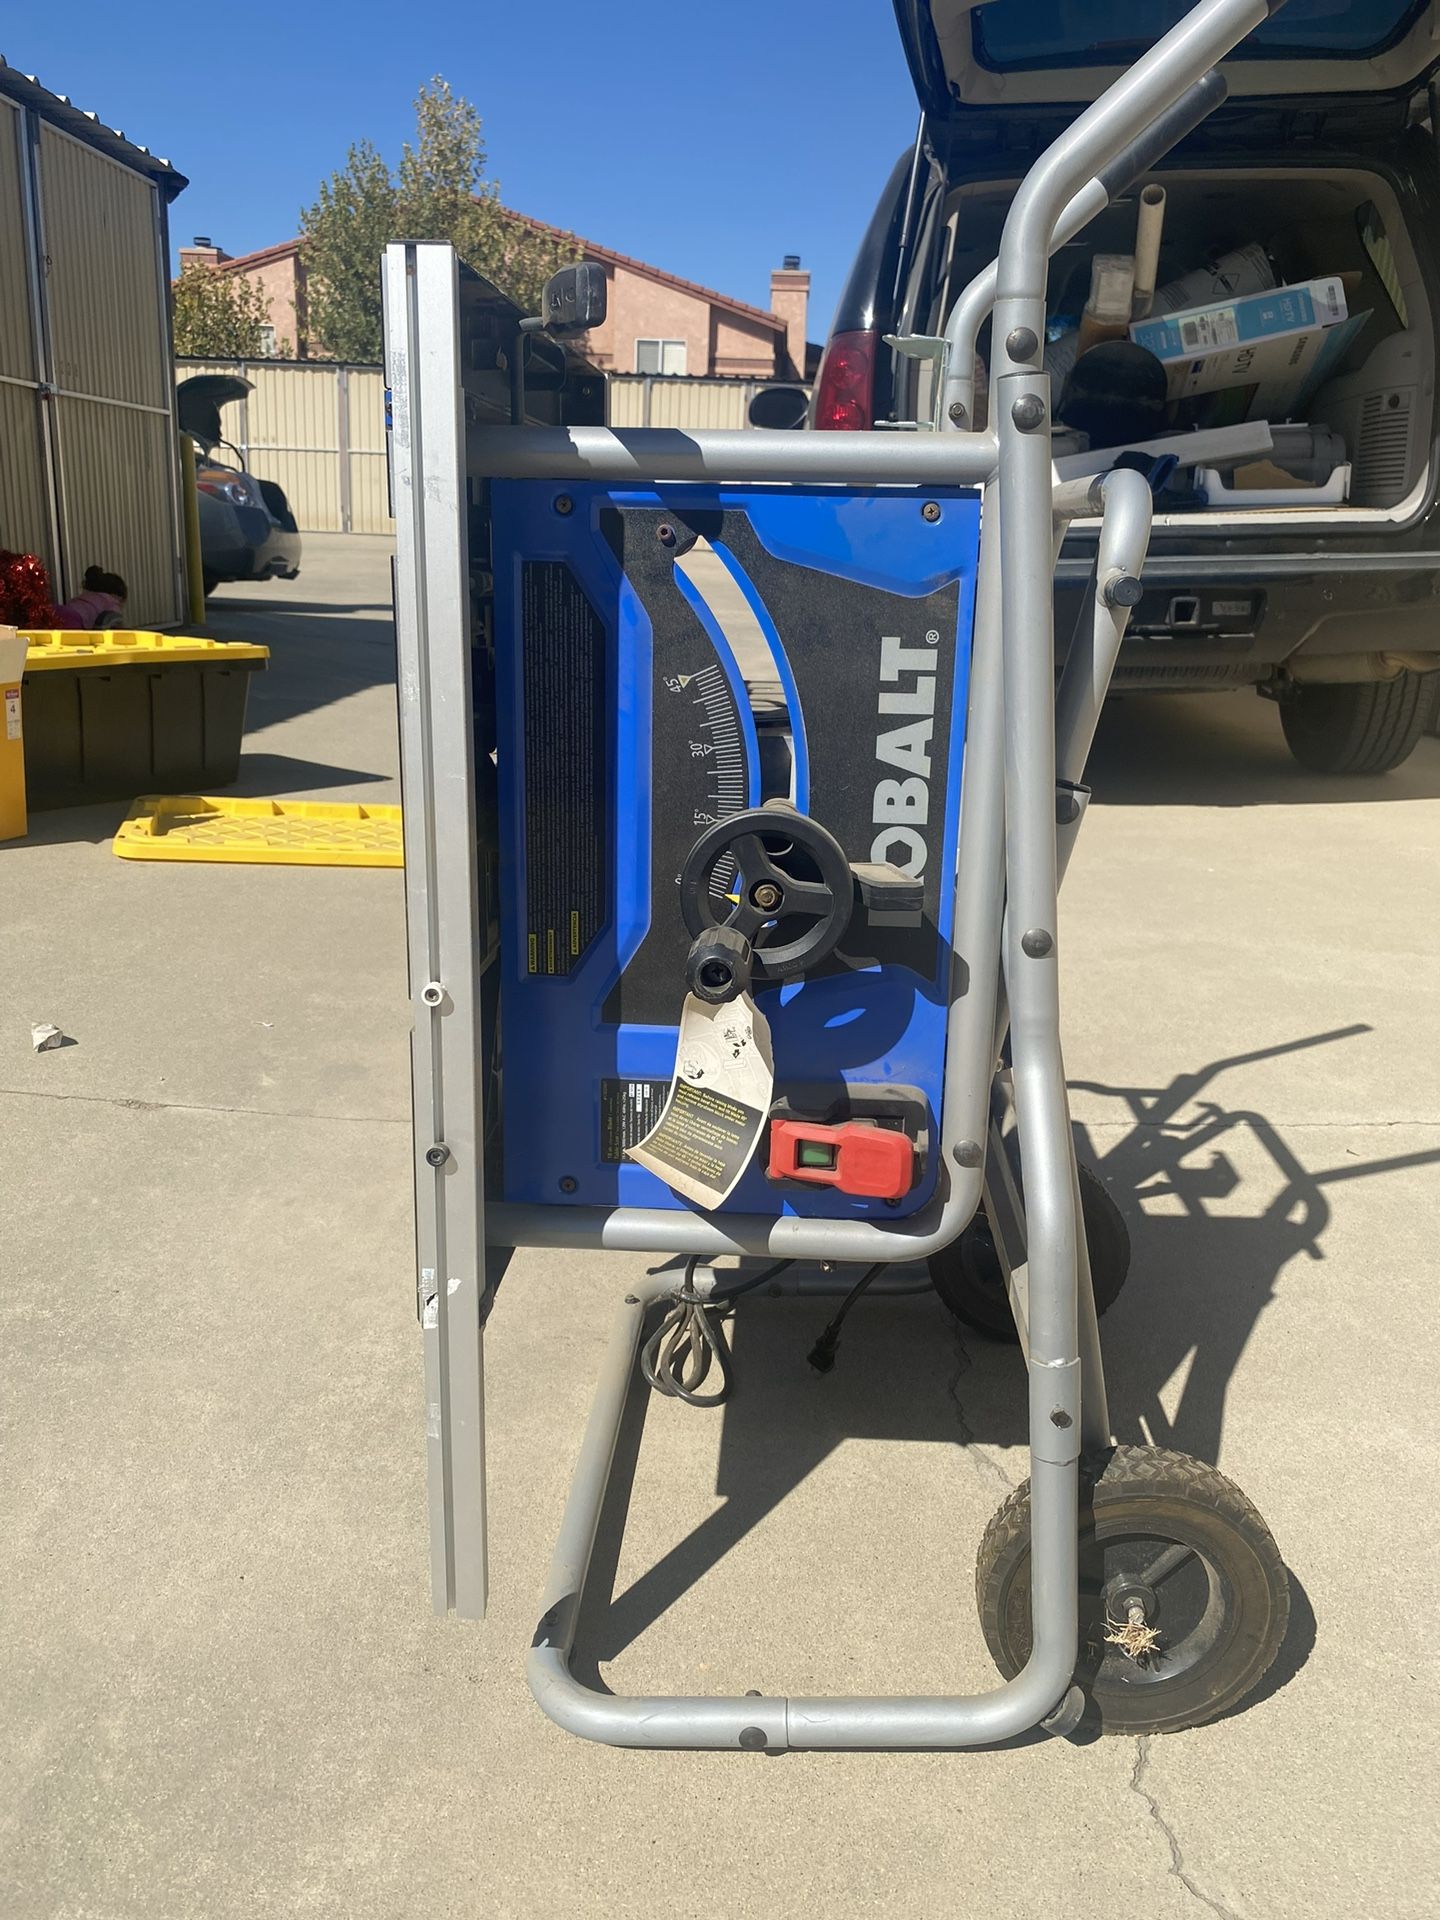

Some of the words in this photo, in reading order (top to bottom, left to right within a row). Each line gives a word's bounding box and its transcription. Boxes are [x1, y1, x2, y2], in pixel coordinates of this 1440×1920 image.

[1232, 346, 1257, 374] HDTV
[662, 676, 681, 694] 45°
[688, 739, 705, 759] 30°
[868, 636, 938, 928] OBALT
[693, 808, 706, 826] 15°
